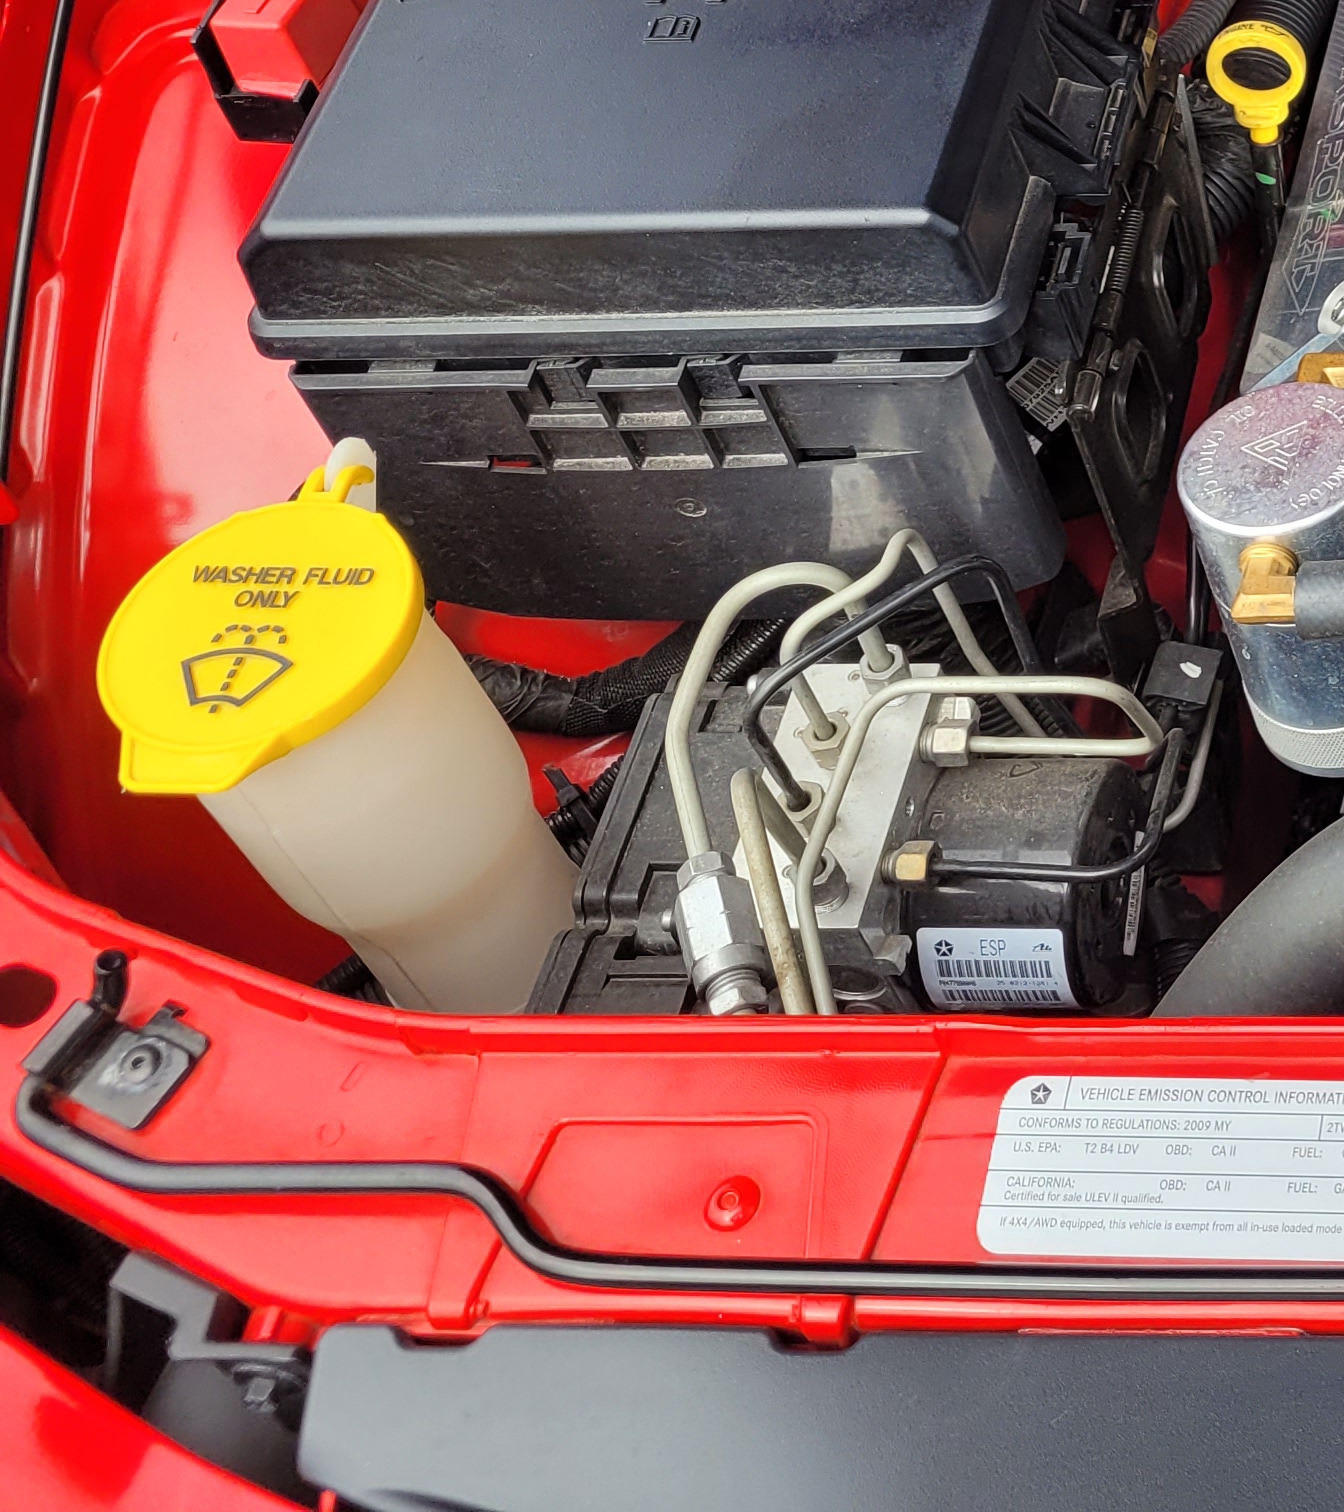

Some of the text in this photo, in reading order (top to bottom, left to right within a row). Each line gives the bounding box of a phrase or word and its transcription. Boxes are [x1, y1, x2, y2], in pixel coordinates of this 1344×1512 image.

[192, 565, 375, 586] WASHER FLUID
[234, 590, 300, 609] ONLY
[979, 939, 1007, 957] ESP
[1080, 1087, 1136, 1101] VEHICLE
[1138, 1088, 1204, 1102] EMISSION
[1207, 1089, 1270, 1103] CONTROL
[1018, 1116, 1232, 1132] CONFORMS TO REGULATIONS: 2009 MY
[1013, 1140, 1062, 1153] U.S. EPA:
[1084, 1142, 1140, 1155] T2 B4 LDV
[1165, 1143, 1192, 1156] OBD:
[1211, 1144, 1226, 1157] CA
[1292, 1146, 1323, 1158] FUEL:
[1006, 1175, 1075, 1189] CALIFORNIA:
[1159, 1178, 1187, 1191] OBD:
[1205, 1179, 1221, 1192] CA
[1286, 1181, 1318, 1193] FUEL:
[1003, 1190, 1045, 1201] Certified
[1046, 1190, 1061, 1201] for
[1062, 1191, 1082, 1202] sale
[1084, 1191, 1111, 1203] ULEV
[1120, 1192, 1164, 1205] qualified.
[999, 1216, 1007, 1226] If
[1008, 1216, 1058, 1229] 4X4/AWD
[1059, 1217, 1106, 1231] equipped,
[1108, 1218, 1126, 1229] this
[1128, 1218, 1162, 1230] vehicle
[1163, 1219, 1172, 1230] is
[1174, 1221, 1210, 1233] exempt
[1211, 1220, 1234, 1232] from
[1236, 1221, 1248, 1232] all
[1250, 1221, 1279, 1233] in-use
[1281, 1221, 1314, 1233] loaded
[1315, 1223, 1343, 1234] mode
